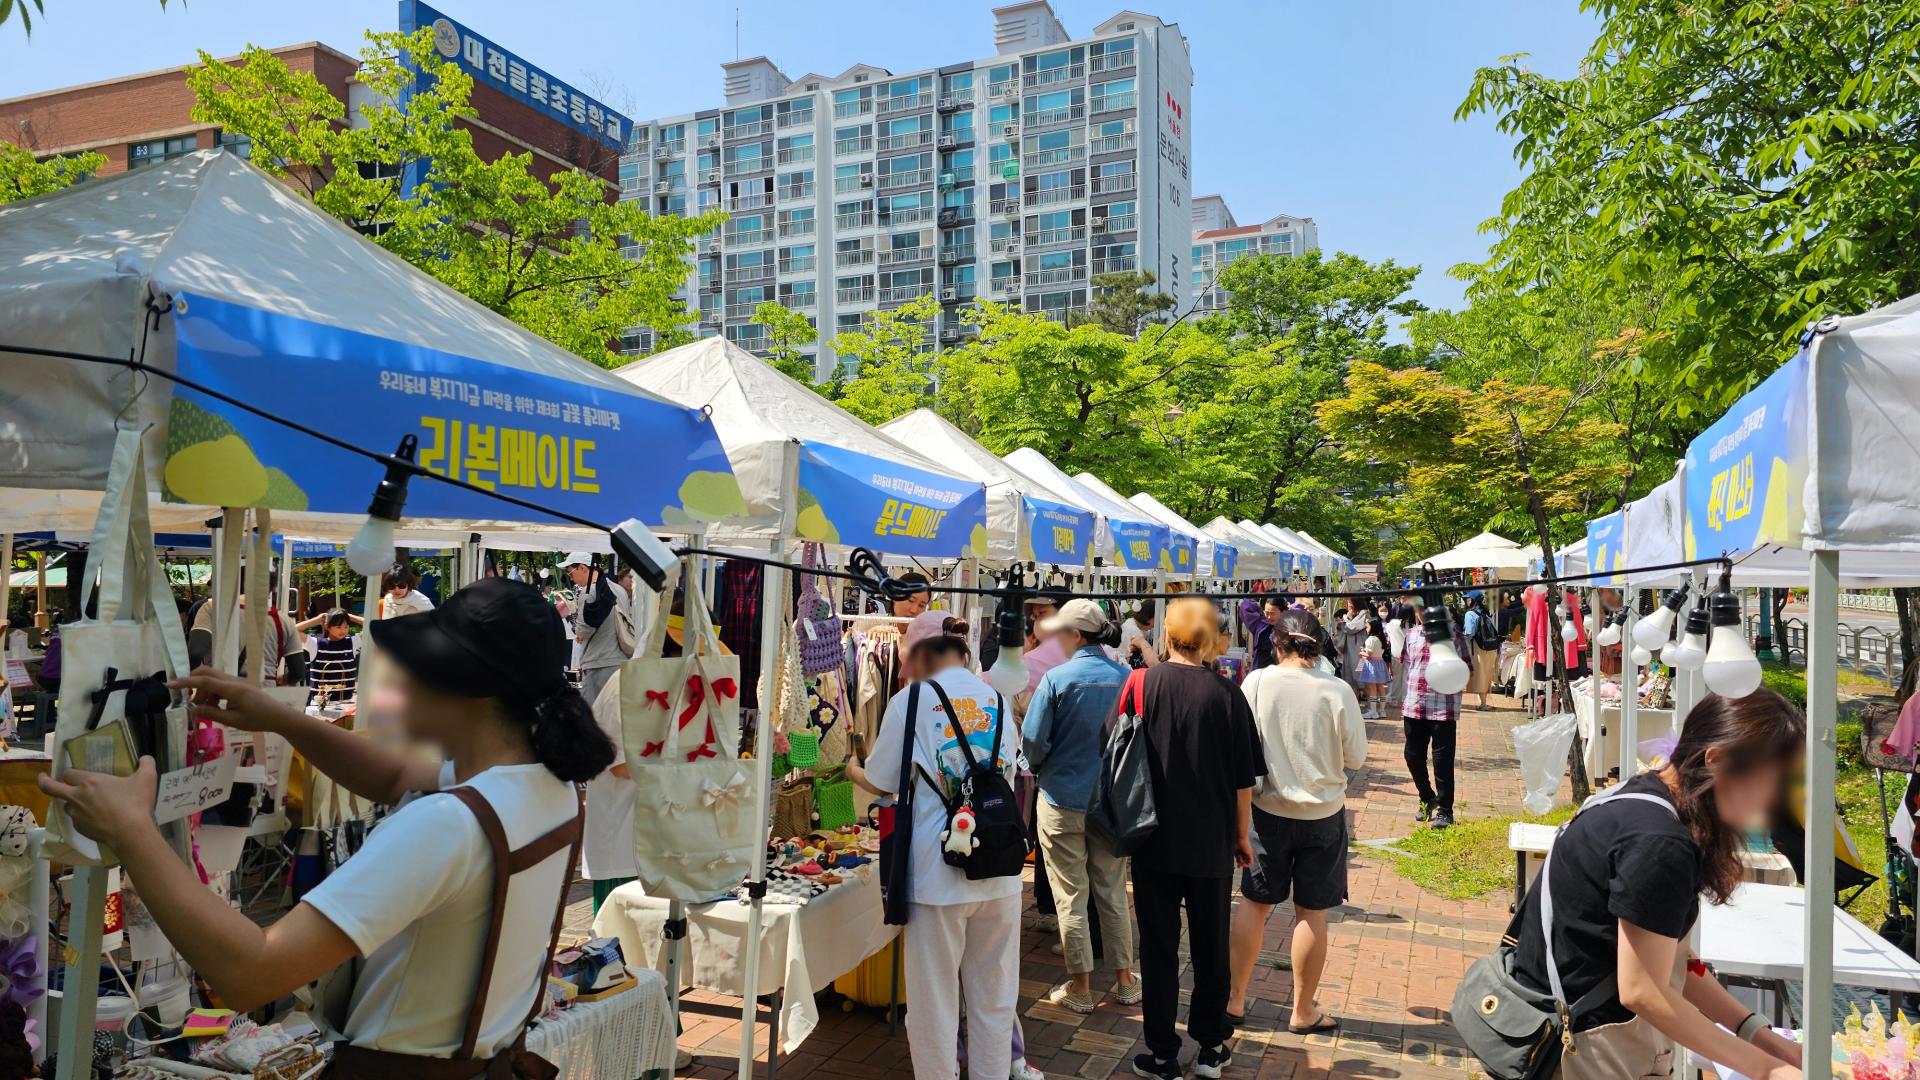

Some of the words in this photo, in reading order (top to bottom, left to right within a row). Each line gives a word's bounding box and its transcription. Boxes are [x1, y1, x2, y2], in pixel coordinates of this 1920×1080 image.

[463, 34, 621, 142] 대전글꽃초등학교
[136, 145, 148, 156] 5-3
[1159, 131, 1188, 180] 문화마을
[380, 370, 427, 396] 우리동네
[429, 376, 481, 407] 복지기금
[482, 389, 513, 412] 마련을
[514, 396, 535, 415] 위한
[535, 399, 561, 418] 제3회
[562, 401, 581, 423] 글꽃
[582, 405, 621, 431] 플리마켓
[418, 415, 600, 493] 리본메이드
